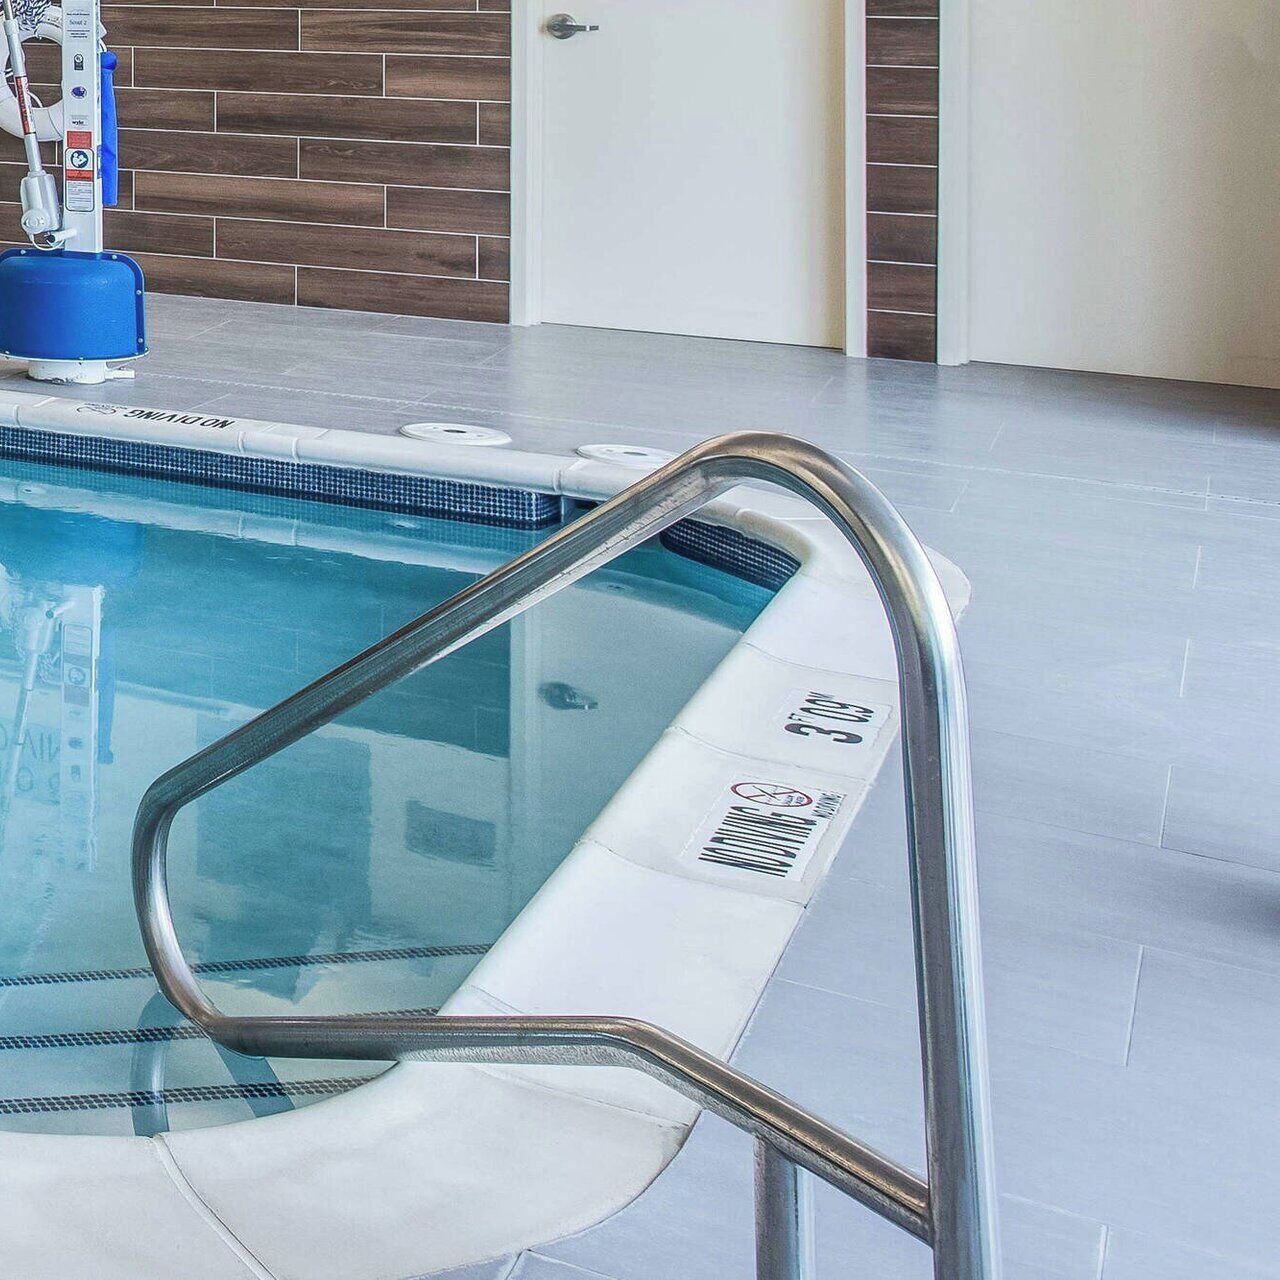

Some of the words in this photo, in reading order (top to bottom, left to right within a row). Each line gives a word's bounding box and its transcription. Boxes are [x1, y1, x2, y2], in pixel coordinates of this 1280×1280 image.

[123, 409, 201, 425] DIVING
[200, 418, 235, 429] NO
[784, 722, 863, 744] 3
[709, 805, 818, 859] DIVING
[698, 847, 793, 878] NO
